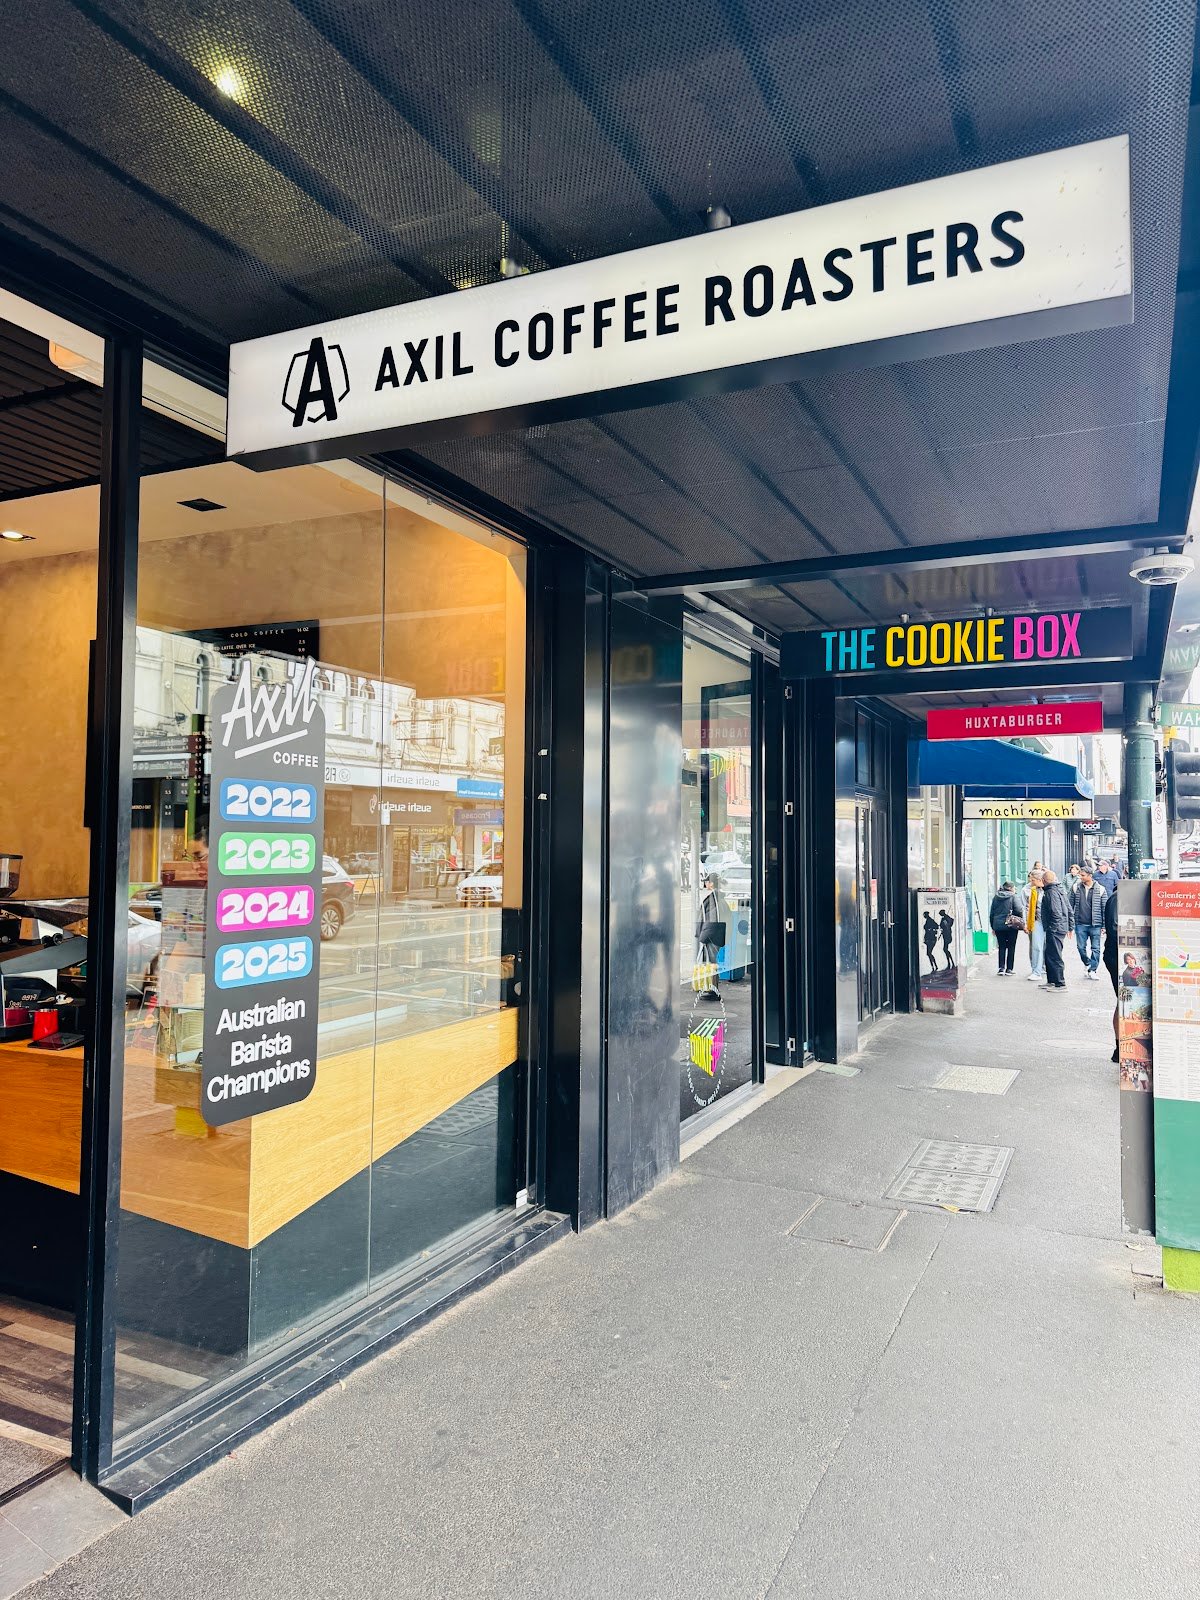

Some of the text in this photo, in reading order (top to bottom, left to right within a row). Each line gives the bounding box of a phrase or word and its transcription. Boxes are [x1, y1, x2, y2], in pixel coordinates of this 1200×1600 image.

[374, 210, 1025, 392] AXIL COFFEE ROASTERS
[820, 612, 1082, 672] THE COOKIE BOX
[220, 655, 318, 748] Axil
[965, 713, 1063, 729] HUXTABURGER
[272, 751, 320, 768] COFFEE
[225, 783, 311, 819] 2022
[978, 802, 1076, 818] machi machi
[224, 838, 311, 871] 2023
[221, 890, 310, 927] 2024
[1157, 890, 1196, 900] Glenferrie
[1165, 900, 1185, 909] guide
[221, 940, 308, 982] 2025
[215, 996, 306, 1036] Australian
[230, 1031, 292, 1068] Barista
[206, 1057, 311, 1103] Champions
